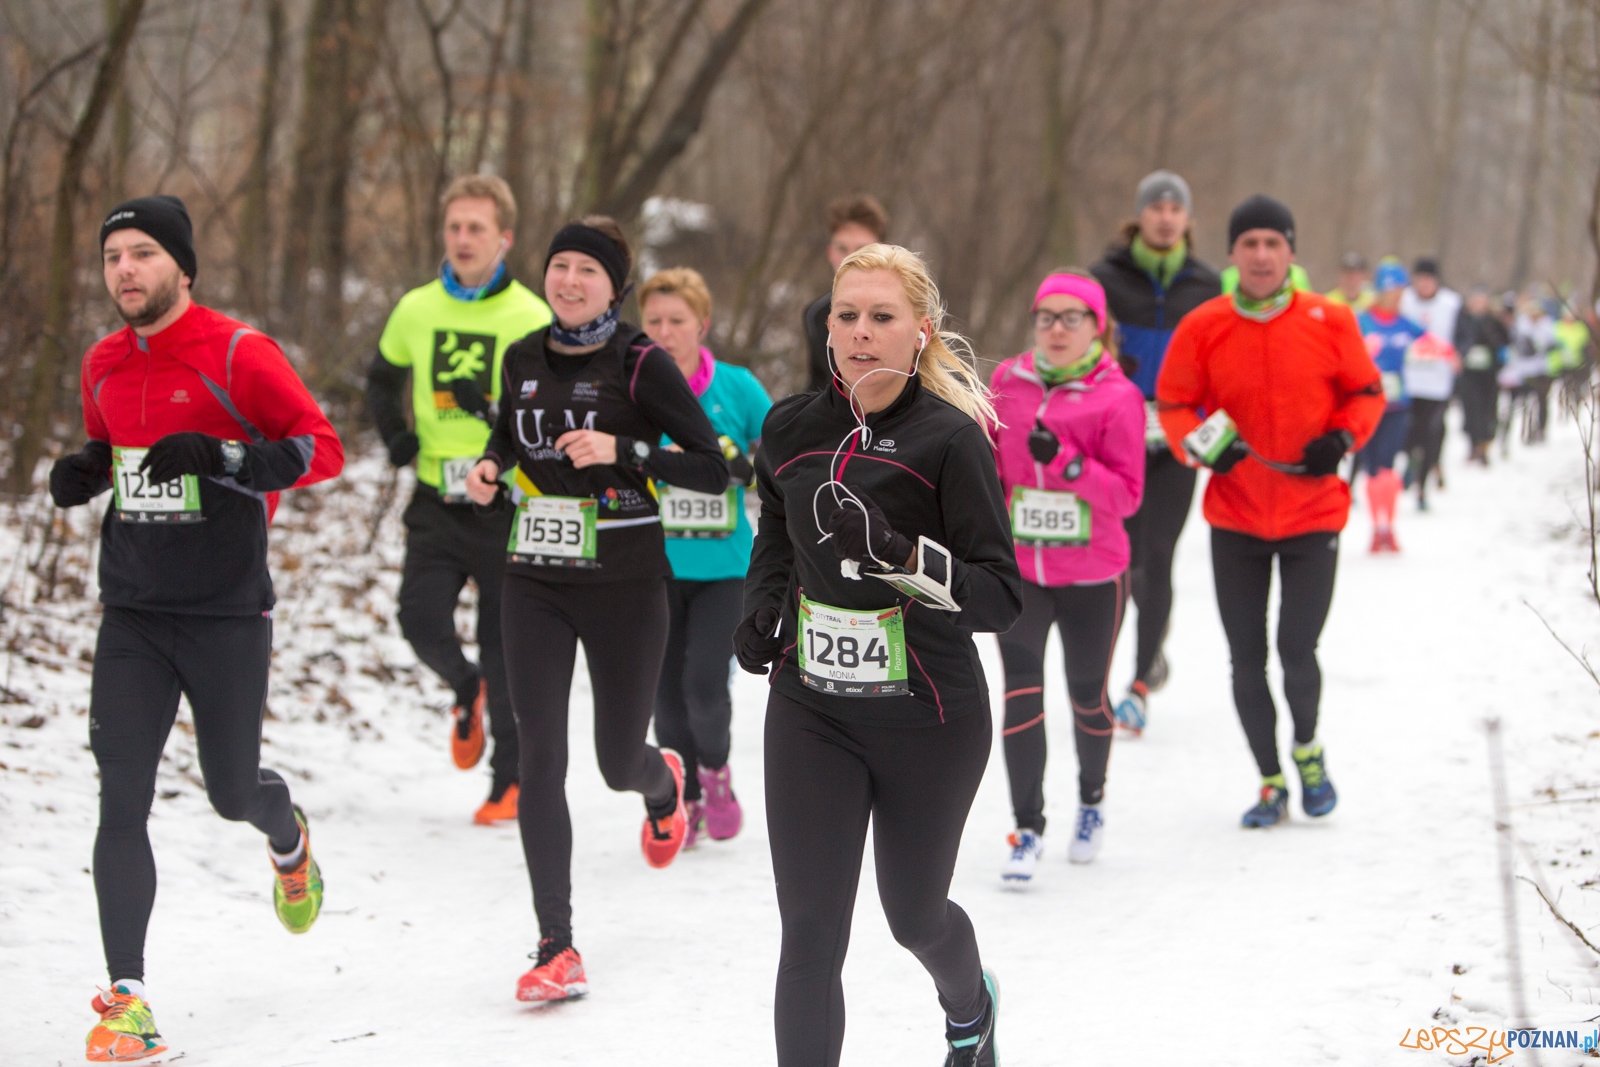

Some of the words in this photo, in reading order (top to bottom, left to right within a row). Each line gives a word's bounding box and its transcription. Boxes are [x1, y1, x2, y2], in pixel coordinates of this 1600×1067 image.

[668, 499, 723, 519] 1938
[1022, 507, 1075, 530] 1585
[524, 517, 581, 545] 1533
[806, 628, 889, 668] 1284
[893, 642, 901, 671] Poznań
[829, 669, 857, 680] MONIA
